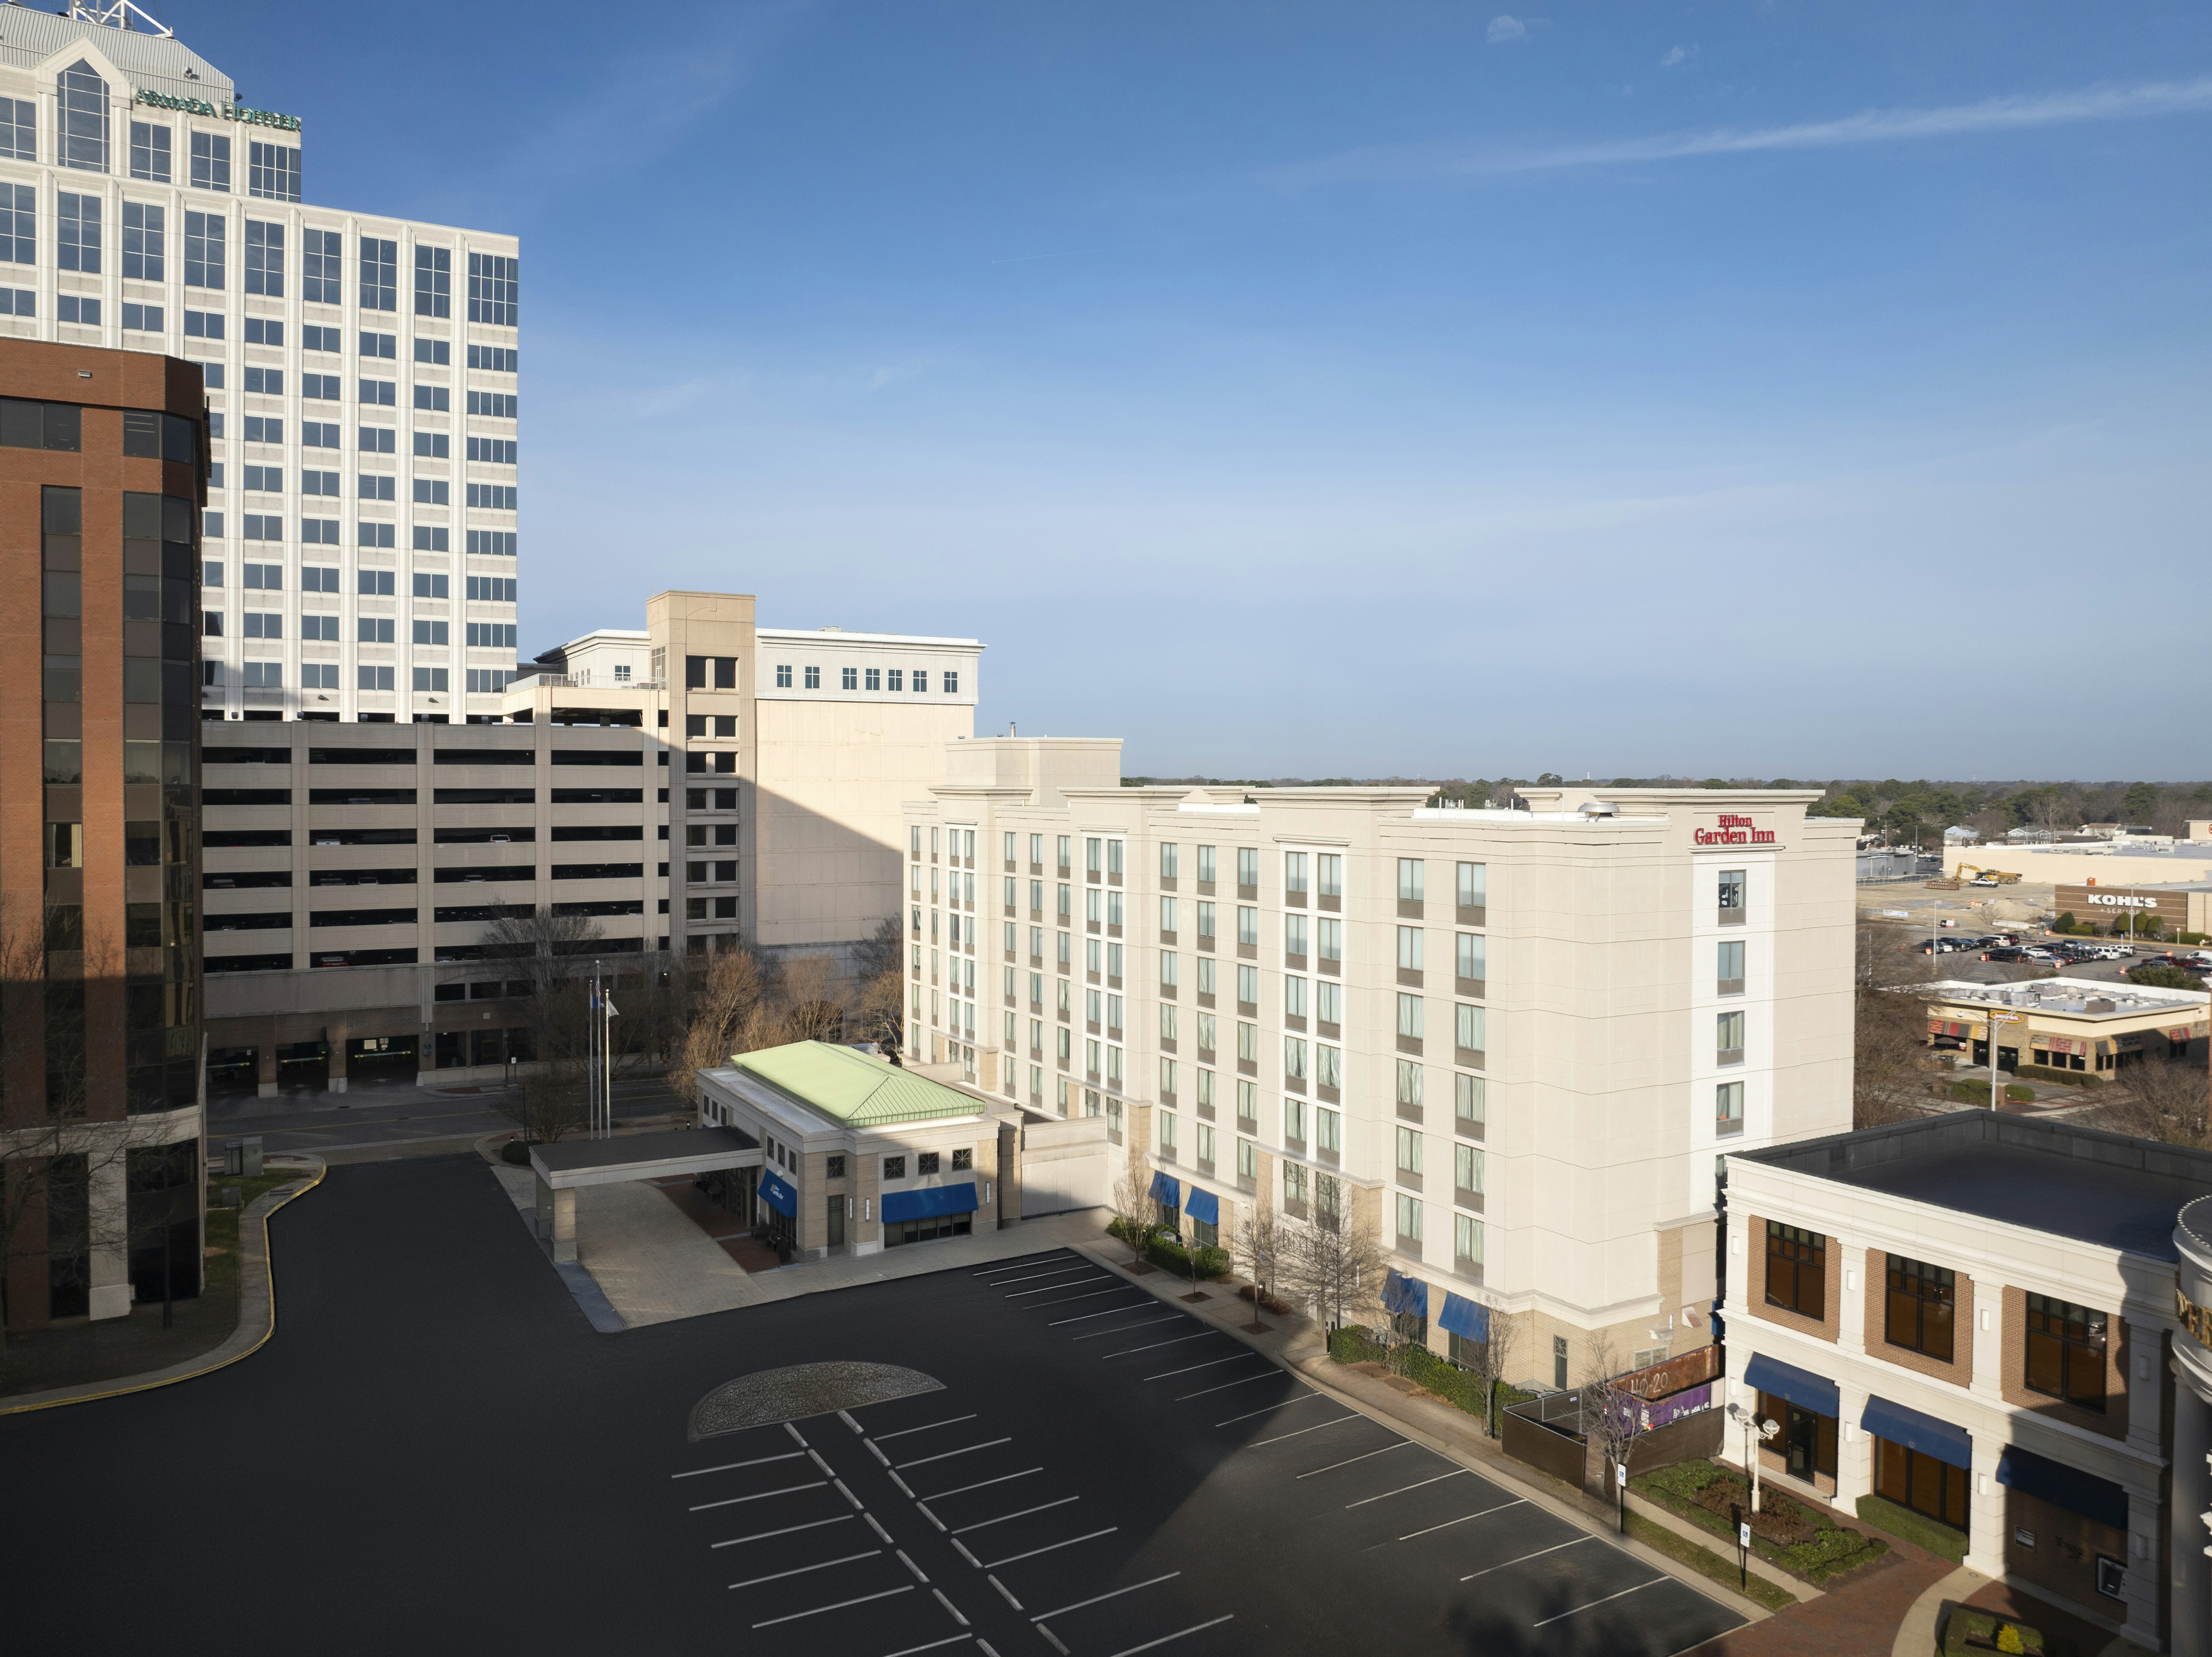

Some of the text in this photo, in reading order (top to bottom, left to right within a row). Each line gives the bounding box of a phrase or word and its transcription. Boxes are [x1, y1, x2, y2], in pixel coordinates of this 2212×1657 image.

[133, 86, 301, 130] ARMADA HOFFLER
[1717, 814, 1753, 827] Hilton
[1693, 827, 1775, 844] Garden Inn
[2088, 894, 2157, 908] KOHL'S
[1631, 1372, 1668, 1397] 40-20
